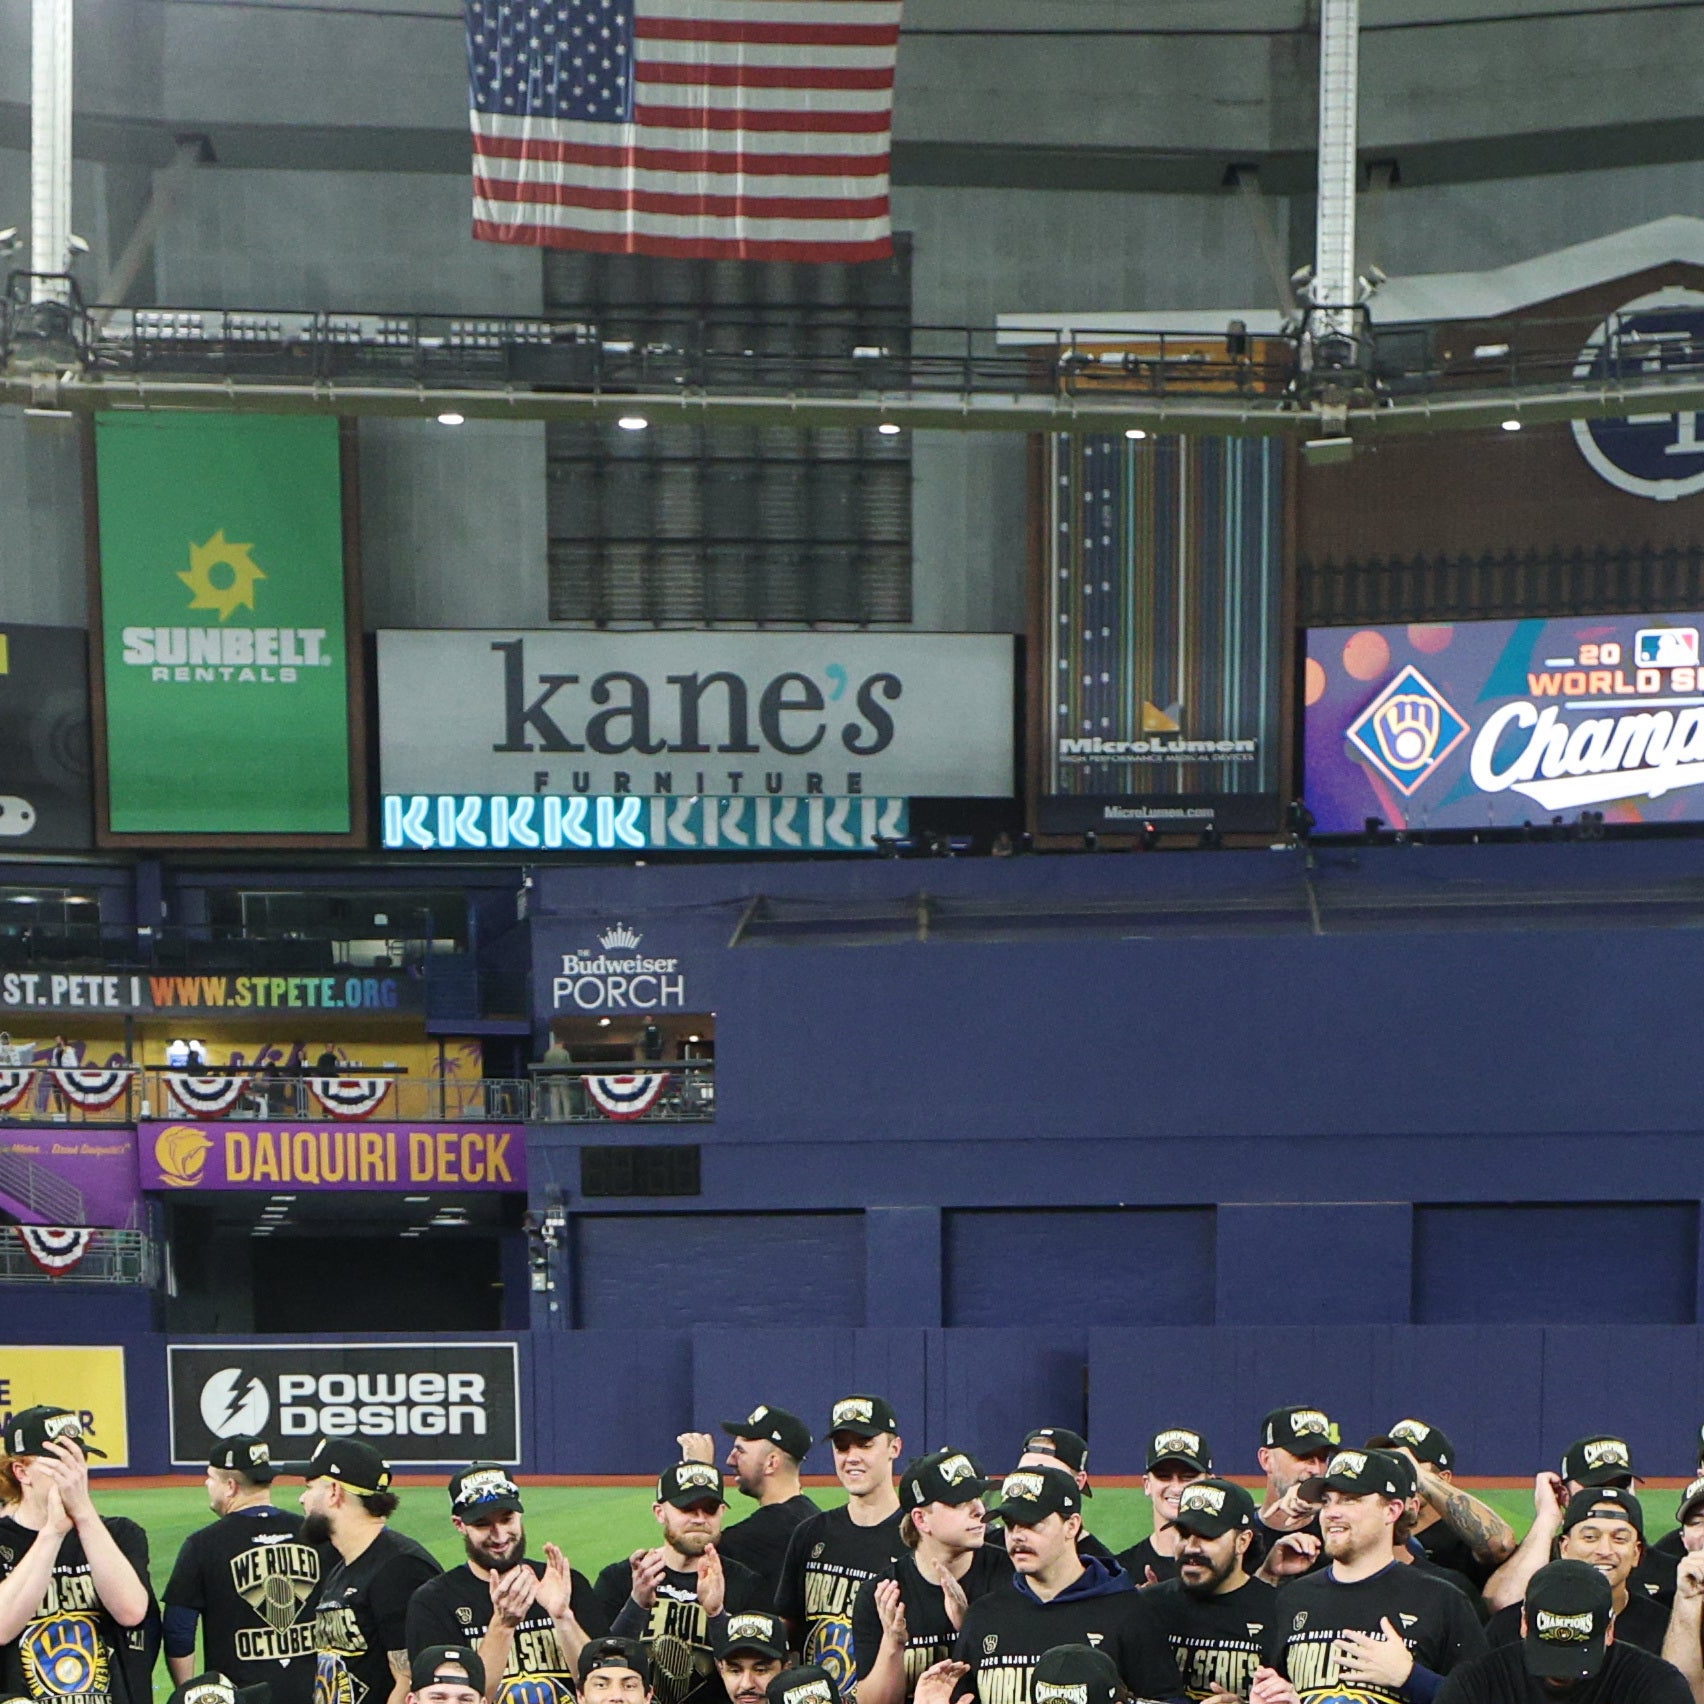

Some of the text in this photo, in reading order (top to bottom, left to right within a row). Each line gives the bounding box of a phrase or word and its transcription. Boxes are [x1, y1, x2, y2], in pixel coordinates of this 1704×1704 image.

[121, 627, 327, 667] SUNBELT
[1579, 643, 1621, 666] 20
[152, 666, 297, 684] RENTALS
[1528, 669, 1664, 697] WORLD
[491, 638, 904, 756] kane's
[1059, 736, 1255, 754] MicroLumen
[534, 771, 863, 794] FURNITURE
[1104, 805, 1215, 819] MicroLumen.com
[562, 953, 678, 975] Budweiser
[577, 949, 591, 957] THE
[3, 972, 48, 1005] ST.
[51, 974, 120, 1007] PETE
[150, 976, 398, 1009] WWW.STPETE.ORG
[552, 974, 685, 1010] PORCH
[226, 1131, 515, 1183] DAIQUIRI DECK
[833, 1400, 872, 1422] CHAMPIONS
[1155, 1430, 1200, 1453] CHAMPIONS
[676, 1463, 718, 1488] CHAMPIONS
[1180, 1485, 1225, 1513] CHAMPIONS
[232, 1544, 320, 1591] WE RULED
[728, 1614, 773, 1639] CHAMPIONS
[1537, 1610, 1593, 1633] CHAMPIONS
